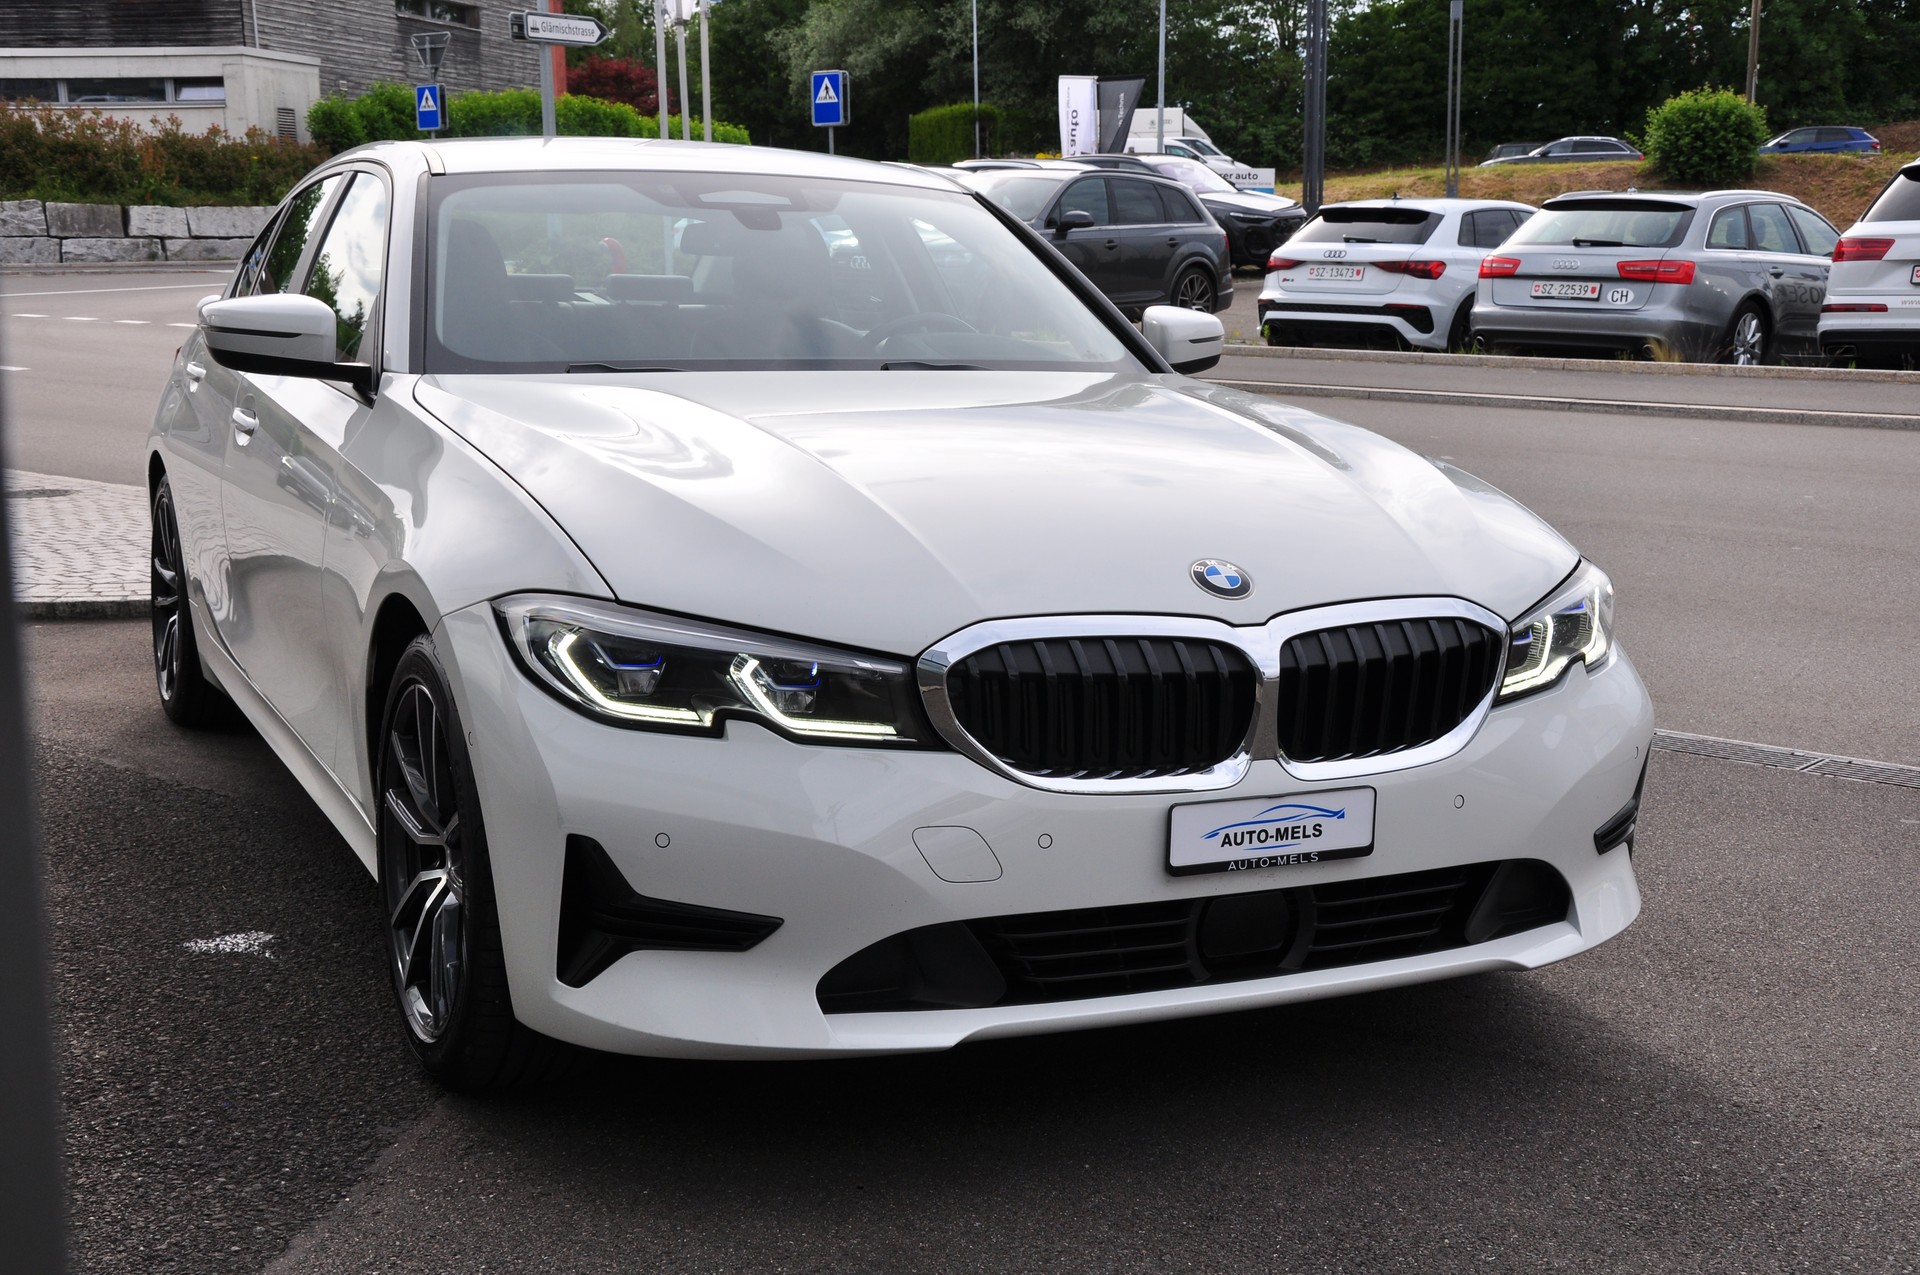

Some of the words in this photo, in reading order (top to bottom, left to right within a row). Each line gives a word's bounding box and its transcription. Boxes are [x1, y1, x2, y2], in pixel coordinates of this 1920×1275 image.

[541, 21, 595, 37] Glärnischstrasse
[1235, 172, 1258, 180] auto
[1611, 290, 1629, 302] CH
[1194, 560, 1238, 572] BMW
[1220, 823, 1323, 848] AUTO-MELS
[1227, 852, 1319, 871] AUTO-MELS
